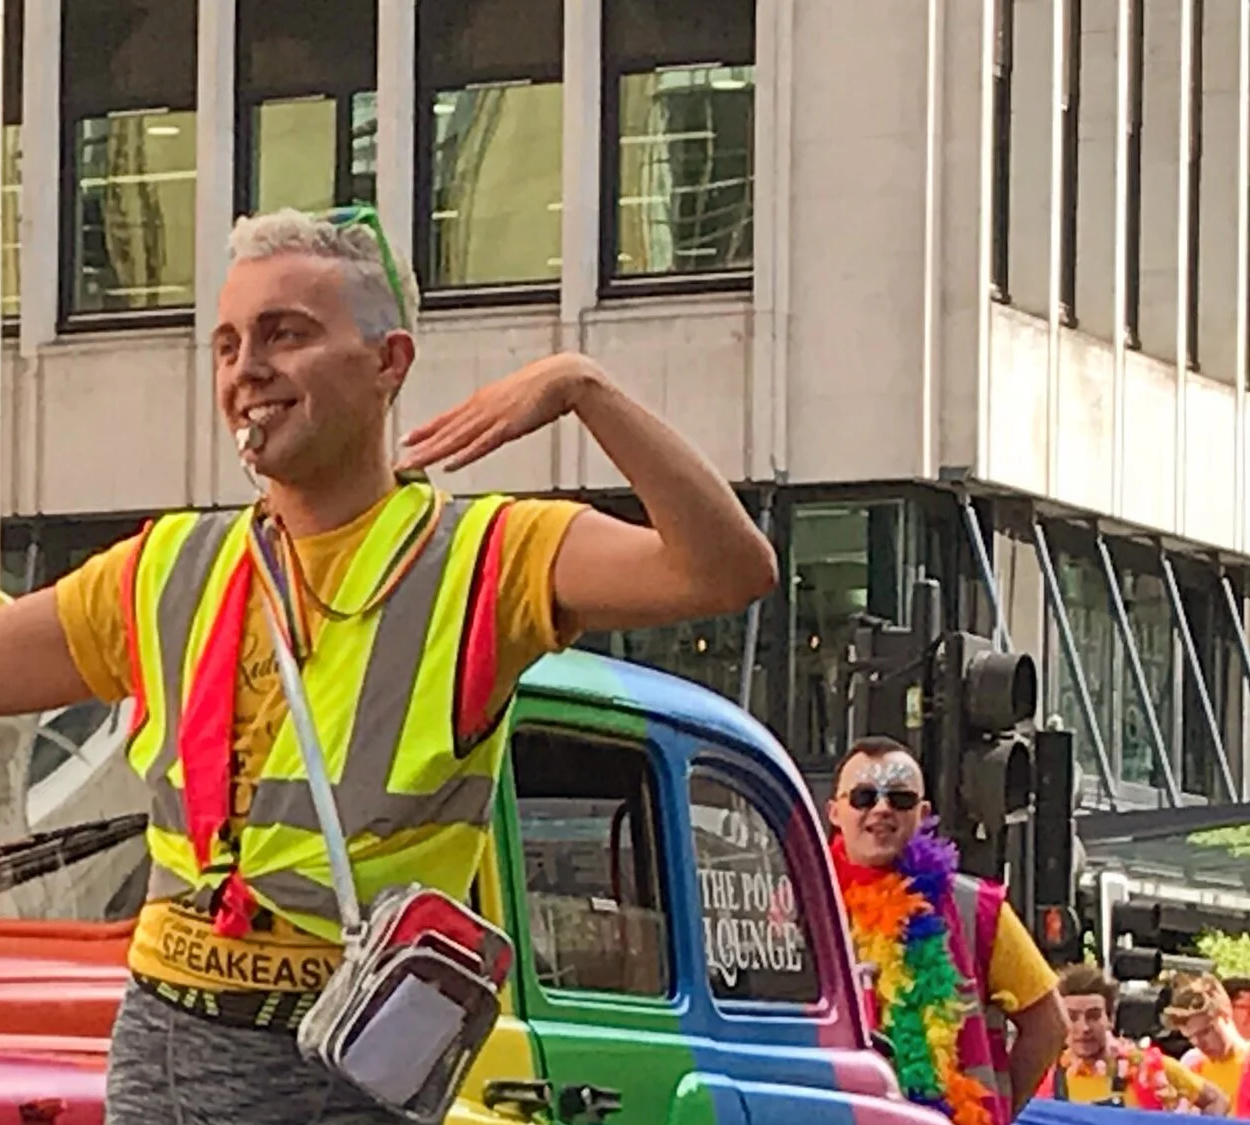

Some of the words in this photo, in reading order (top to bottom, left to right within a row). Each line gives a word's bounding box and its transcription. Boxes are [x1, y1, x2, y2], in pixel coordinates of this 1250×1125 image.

[697, 869, 740, 910] THE
[741, 873, 794, 912] POLO
[702, 916, 803, 987] LOUNGE
